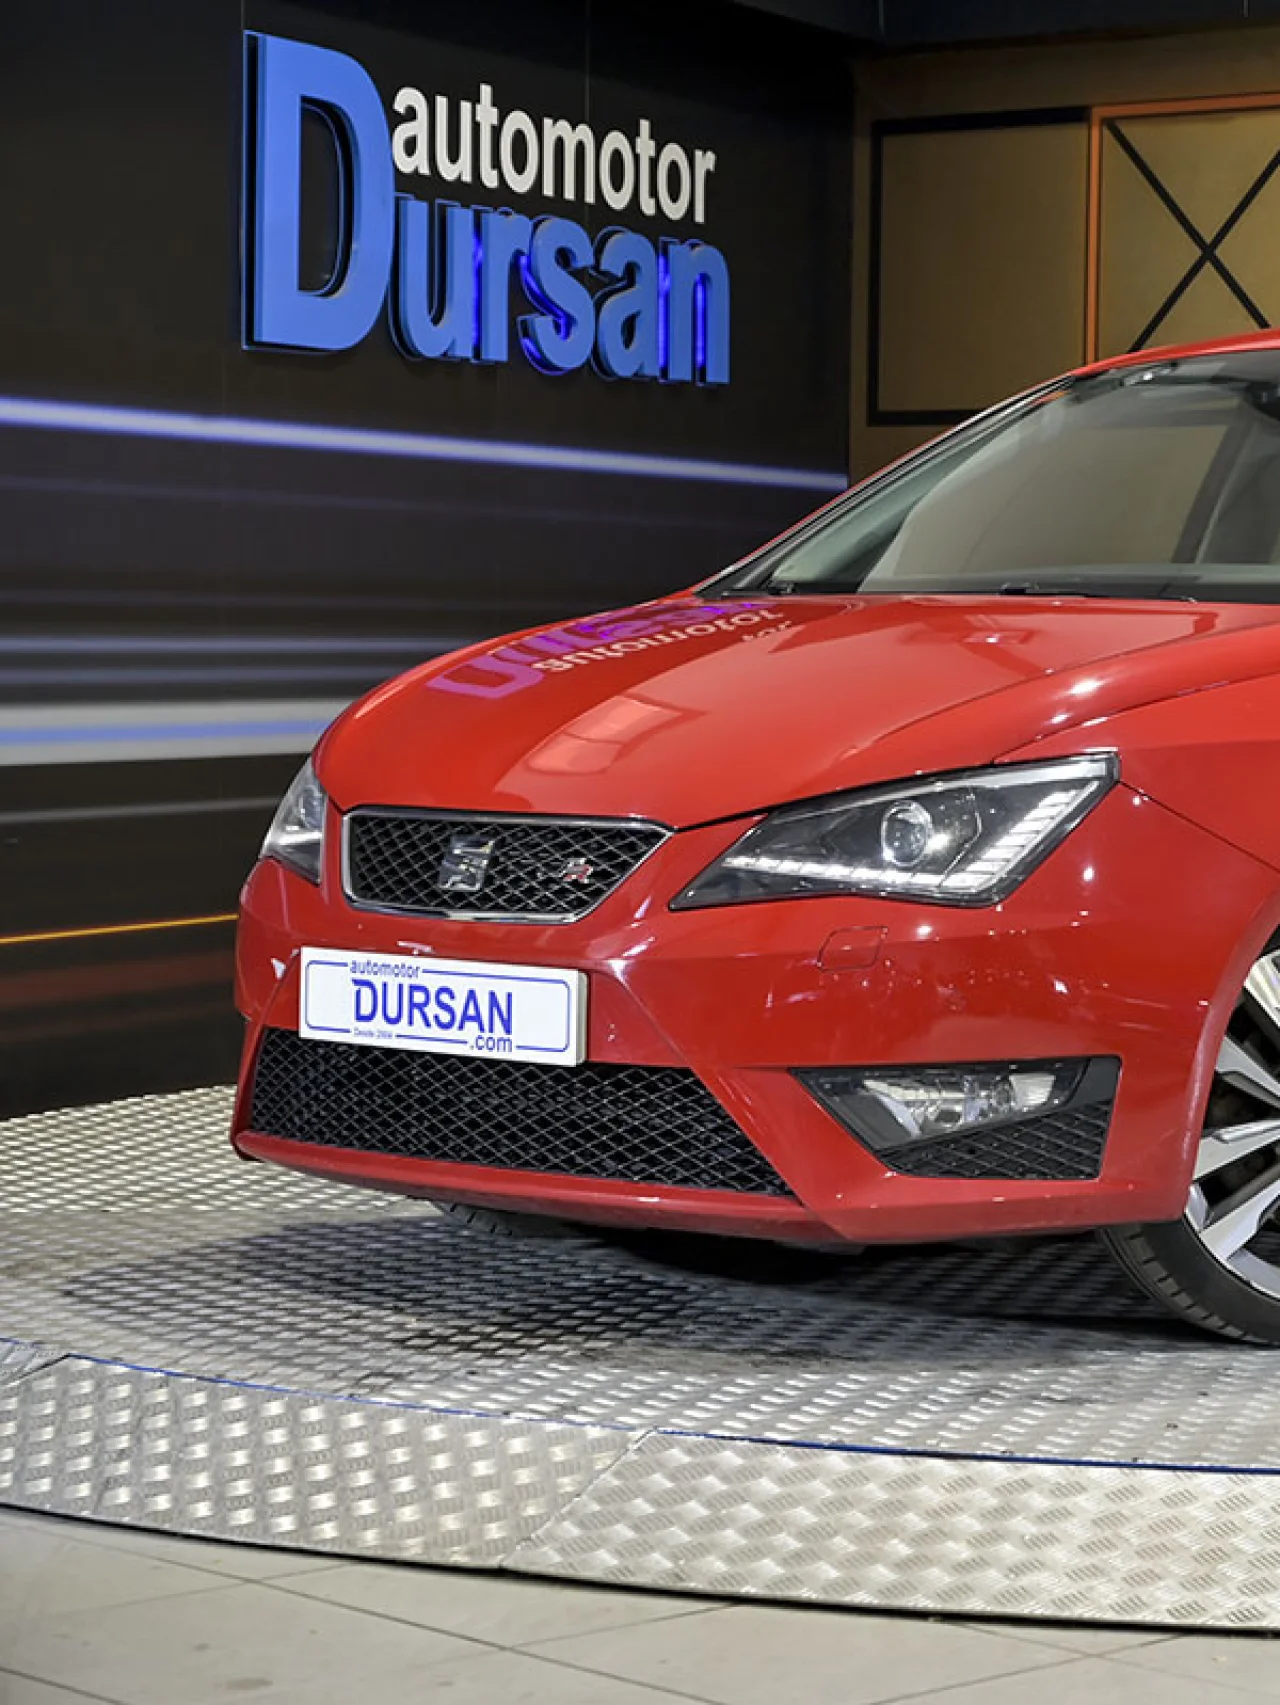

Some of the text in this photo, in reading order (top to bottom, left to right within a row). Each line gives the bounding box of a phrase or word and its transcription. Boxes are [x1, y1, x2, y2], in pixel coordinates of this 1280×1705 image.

[391, 82, 717, 223] automotor
[242, 29, 731, 386] Dursan
[349, 960, 421, 979] automotor
[351, 978, 513, 1036] DURSAN
[469, 1034, 513, 1053] .com
